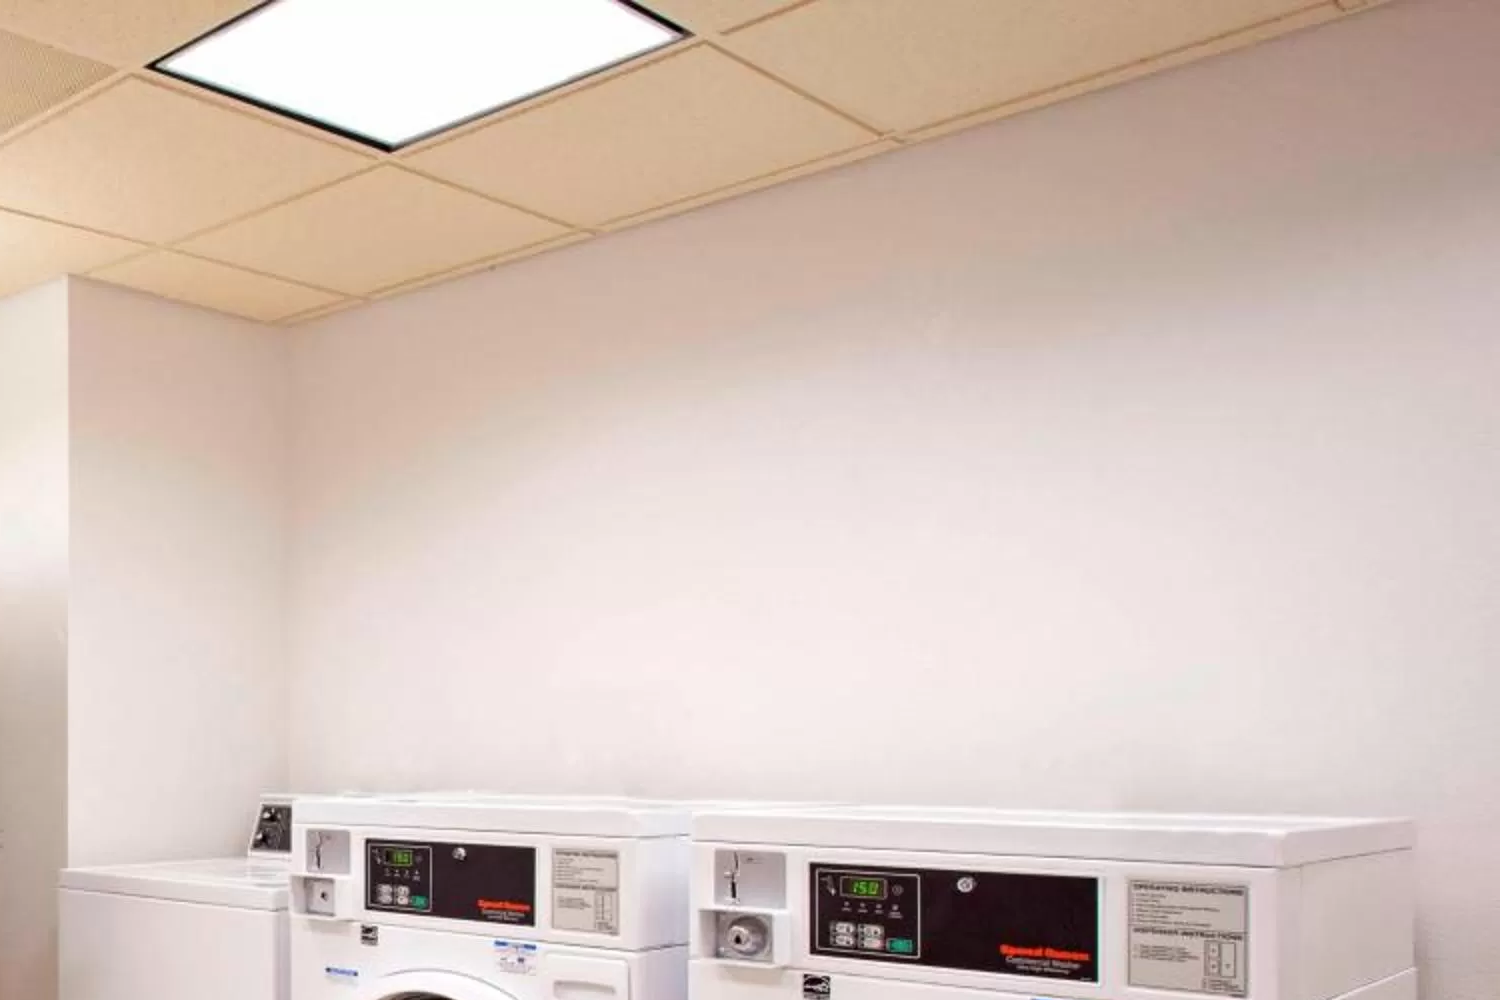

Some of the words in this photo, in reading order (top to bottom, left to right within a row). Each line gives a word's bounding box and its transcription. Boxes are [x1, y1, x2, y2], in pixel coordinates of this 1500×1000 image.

[1132, 883, 1179, 893] OPERATING
[1181, 886, 1244, 896] INSTRUCTIONS
[999, 944, 1043, 957] Speed
[1045, 947, 1089, 961] Queen
